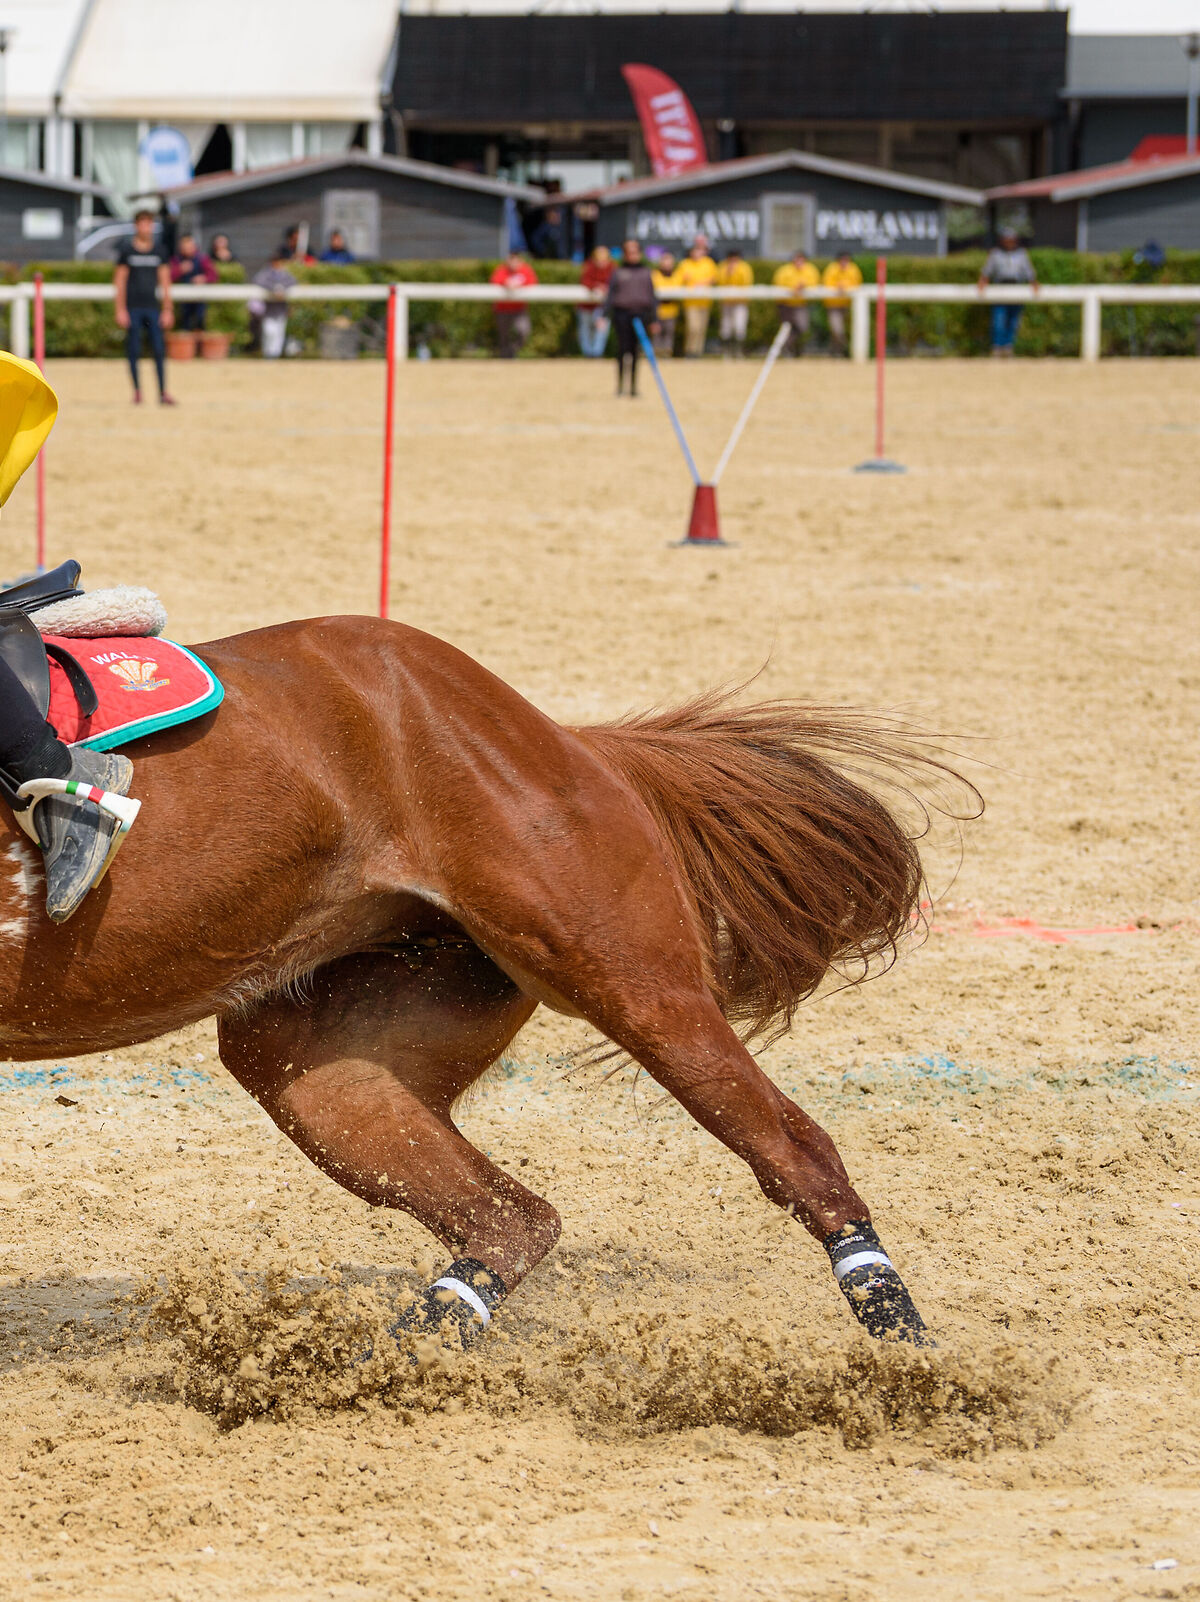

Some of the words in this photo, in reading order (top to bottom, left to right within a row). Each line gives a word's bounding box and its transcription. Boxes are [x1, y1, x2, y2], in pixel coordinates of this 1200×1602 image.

[637, 210, 759, 239] PARLANTI
[816, 210, 938, 239] PARLANTI
[90, 651, 156, 665] WAL
